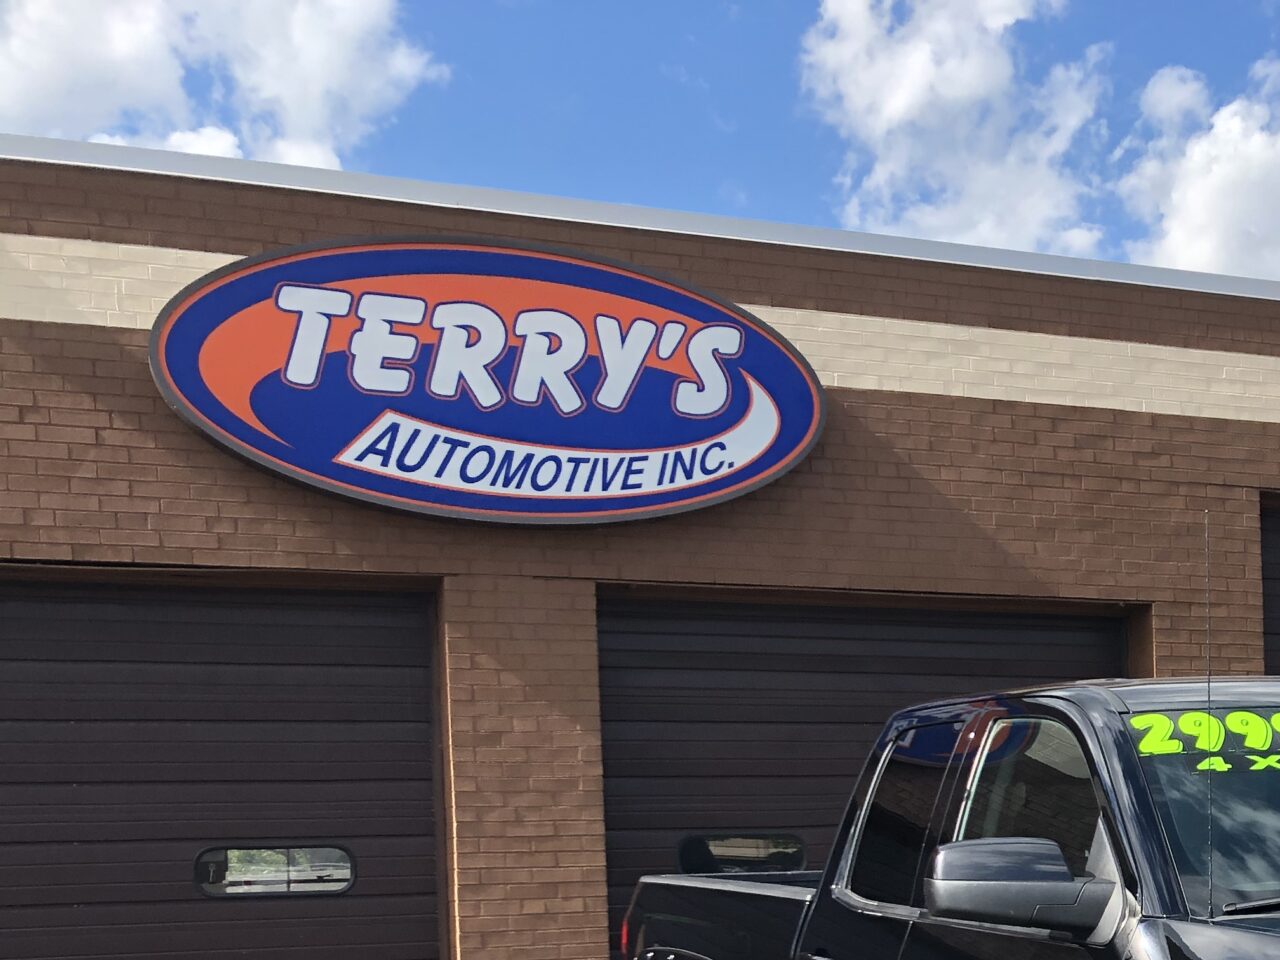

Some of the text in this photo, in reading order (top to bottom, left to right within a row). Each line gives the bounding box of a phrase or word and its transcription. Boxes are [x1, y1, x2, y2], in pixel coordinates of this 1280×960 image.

[274, 283, 742, 417] TERRY'S
[354, 420, 736, 494] AUTOMOTIVE INC.
[1196, 756, 1233, 772] 4
